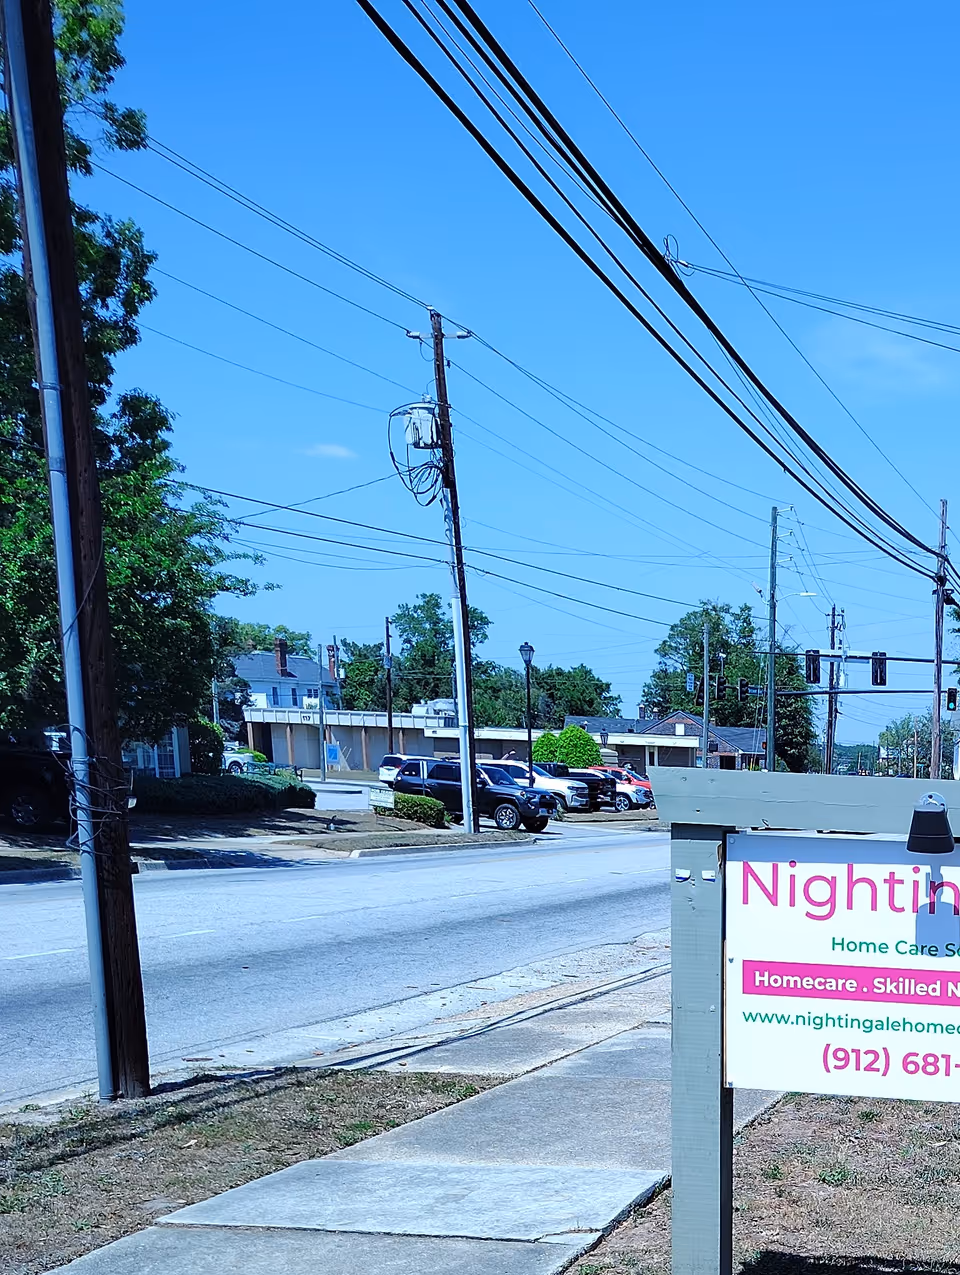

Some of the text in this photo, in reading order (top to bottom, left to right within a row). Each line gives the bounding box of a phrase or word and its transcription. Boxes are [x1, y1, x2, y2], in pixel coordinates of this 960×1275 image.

[831, 937, 889, 955] Home
[895, 940, 939, 957] Care
[753, 971, 858, 993] Homecare
[872, 978, 942, 997] Skilled
[822, 1043, 891, 1076] (912)
